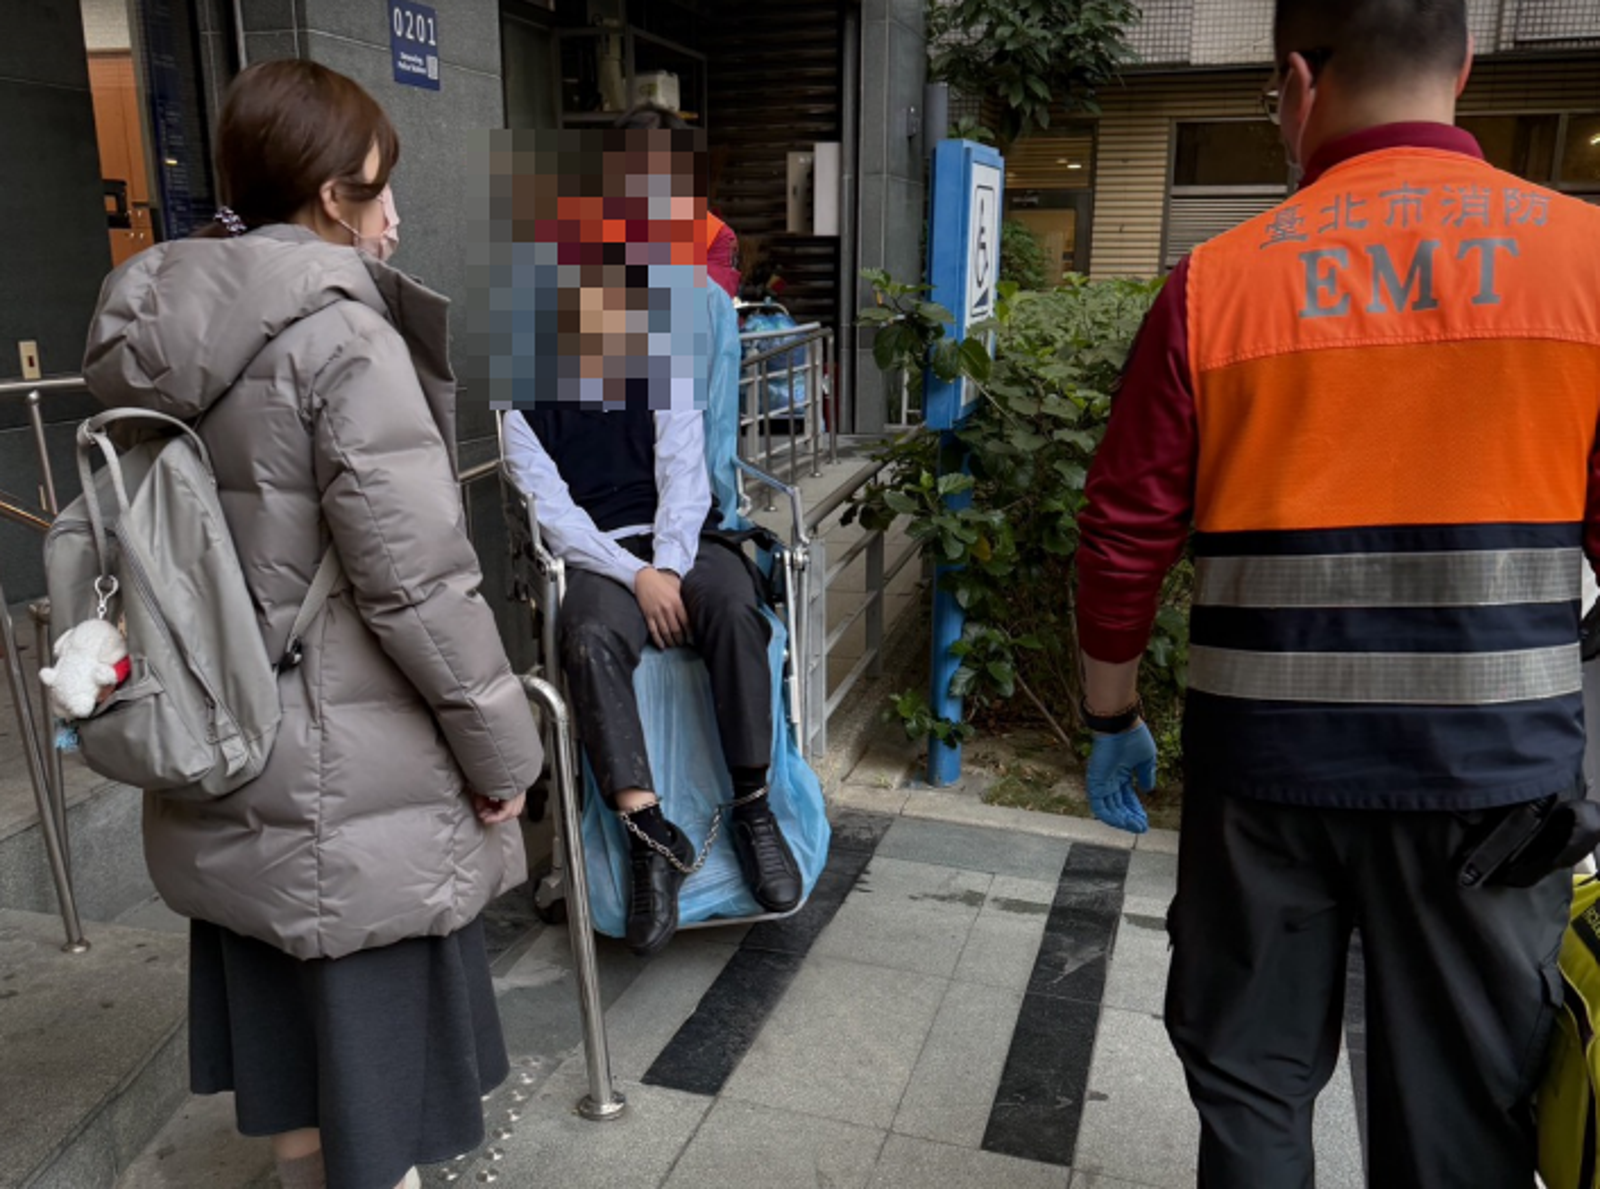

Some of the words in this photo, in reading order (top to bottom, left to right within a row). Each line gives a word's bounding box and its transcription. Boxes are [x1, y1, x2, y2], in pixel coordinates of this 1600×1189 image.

[393, 7, 436, 46] 0201
[1259, 181, 1552, 250] 臺北市消防
[1298, 238, 1519, 319] EMT
